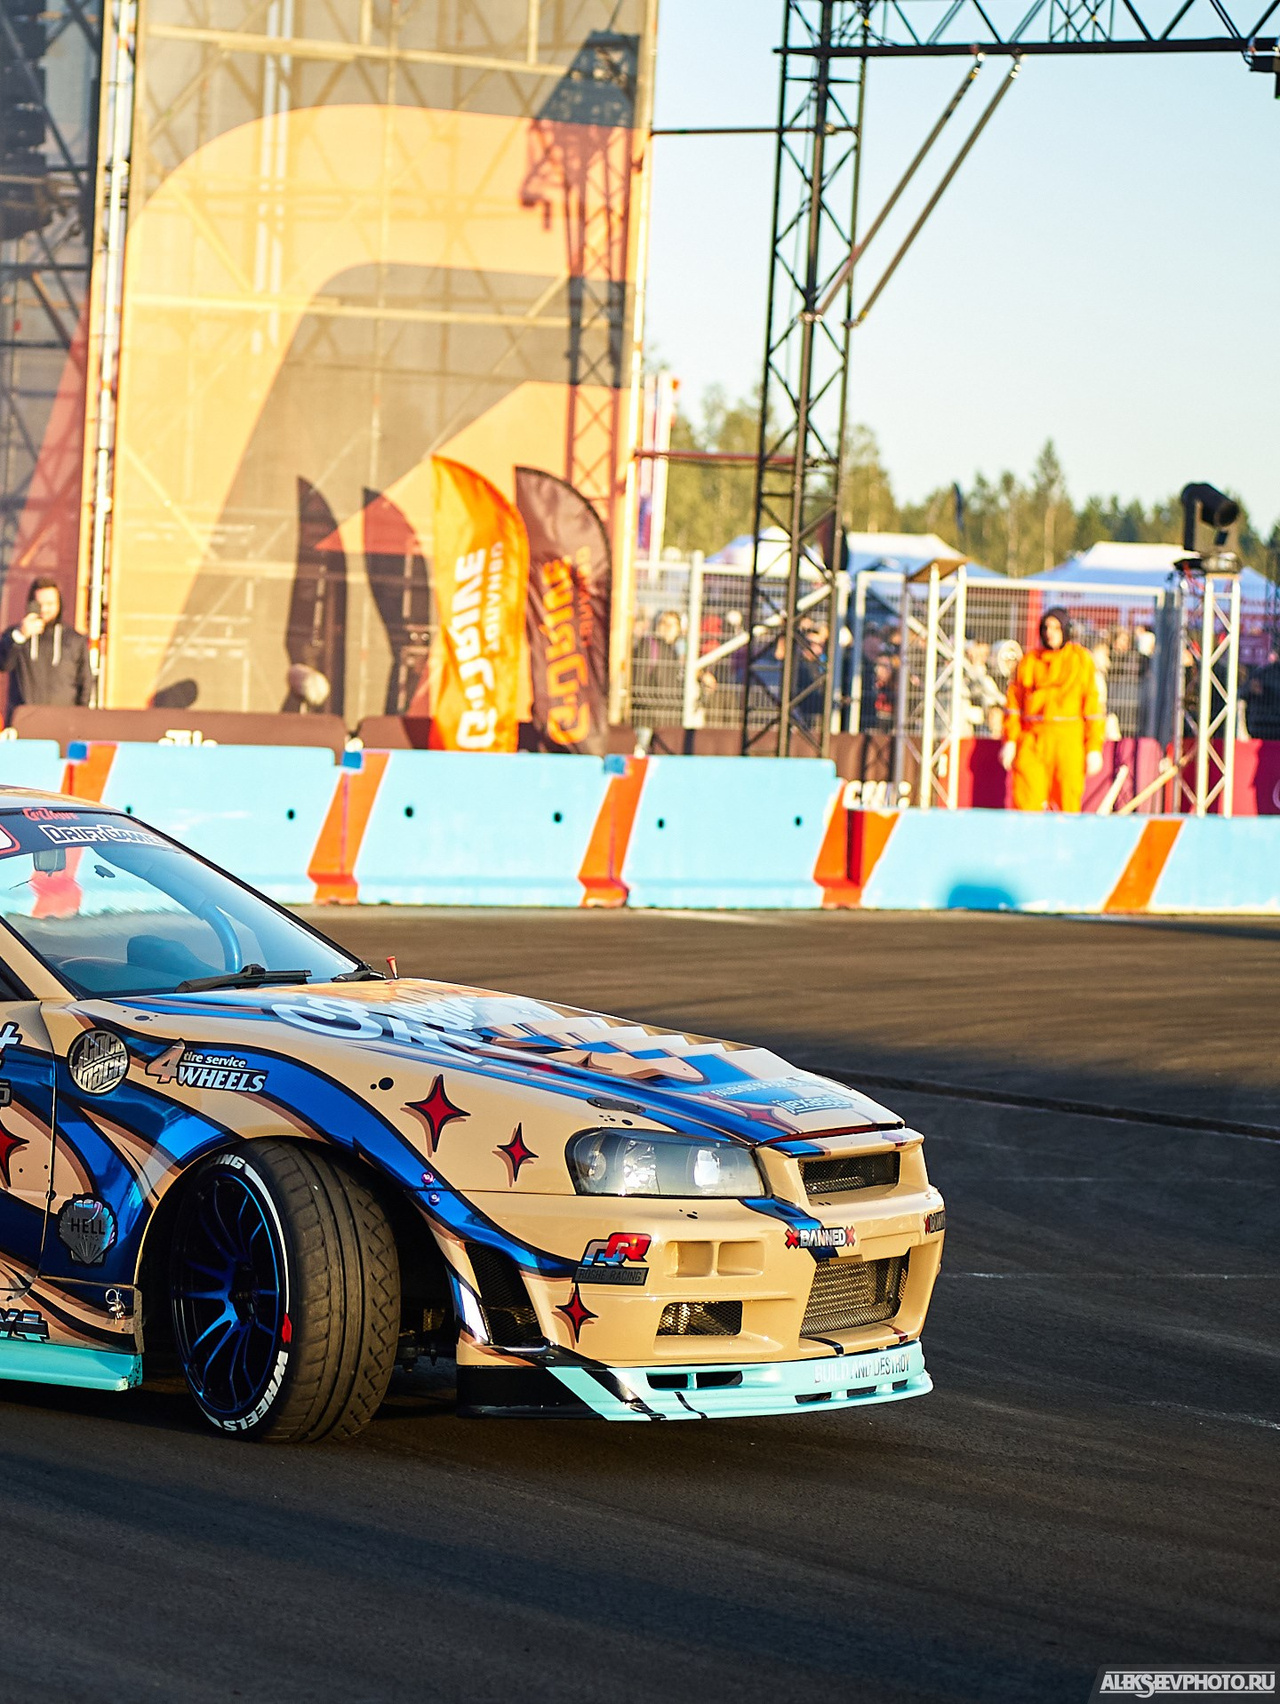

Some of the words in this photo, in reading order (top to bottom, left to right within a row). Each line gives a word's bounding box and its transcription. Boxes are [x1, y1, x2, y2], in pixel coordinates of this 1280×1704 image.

[183, 1052, 204, 1063] tire
[205, 1054, 247, 1069] service
[178, 1066, 267, 1092] WHEELS
[71, 1217, 106, 1236] HELL
[850, 1359, 872, 1379] AND
[873, 1353, 911, 1376] DESTROY
[222, 1349, 289, 1432] WHEELS
